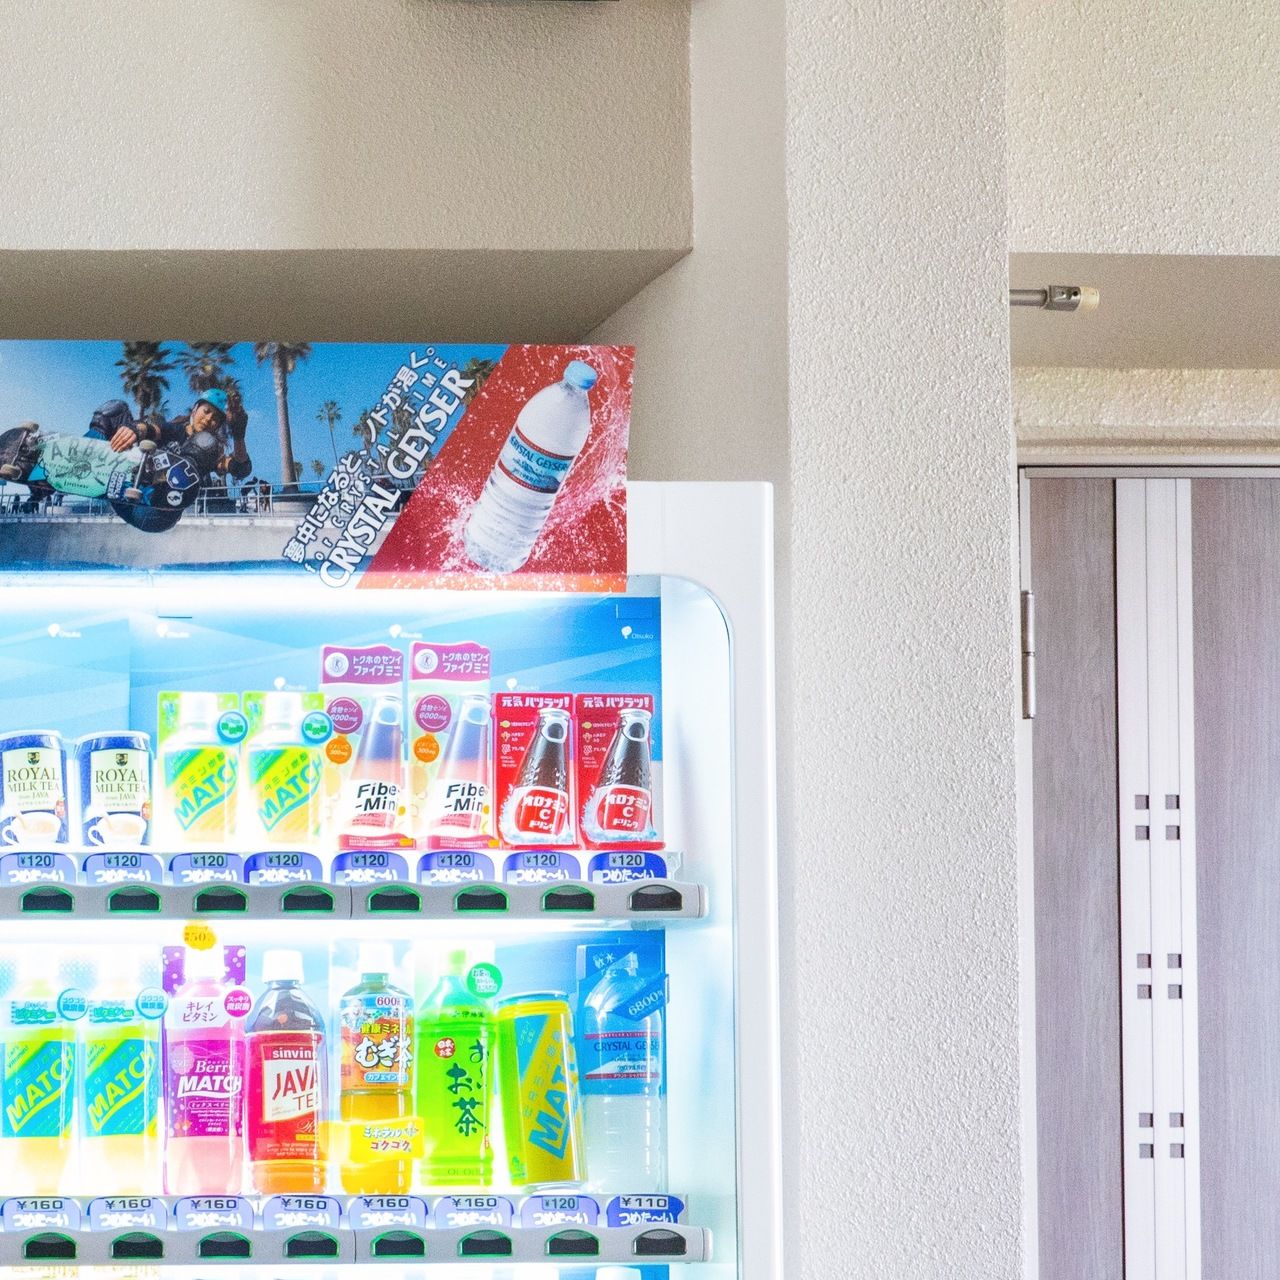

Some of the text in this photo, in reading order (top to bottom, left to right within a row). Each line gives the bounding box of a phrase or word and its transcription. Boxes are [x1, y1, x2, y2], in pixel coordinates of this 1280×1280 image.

[403, 357, 448, 414] TIME
[319, 368, 475, 588] CRYSTAL GEYSER
[7, 767, 60, 782] ROYAL
[95, 769, 147, 783] ROYAL
[8, 782, 40, 793] MILK
[96, 783, 124, 793] MILK
[539, 807, 551, 819] C
[623, 807, 634, 818] C
[21, 855, 52, 867] ¥120
[107, 855, 138, 867] ¥120
[193, 855, 224, 867] ¥120
[268, 855, 299, 867] ¥120
[354, 855, 385, 867] ¥120
[440, 855, 471, 867] ¥120
[526, 855, 557, 867] ¥120
[612, 855, 643, 867] ¥120
[186, 1002, 213, 1011] キレイ
[182, 1012, 218, 1022] ビタミン
[178, 1075, 243, 1096] MATCH
[17, 1199, 63, 1210] ¥160
[106, 1199, 151, 1210] ¥160
[191, 1198, 237, 1210] ¥160
[281, 1198, 327, 1209] ¥160
[363, 1198, 409, 1209] ¥160
[452, 1198, 497, 1209] ¥160
[544, 1197, 576, 1209] ¥120
[621, 1196, 668, 1209] ¥110
